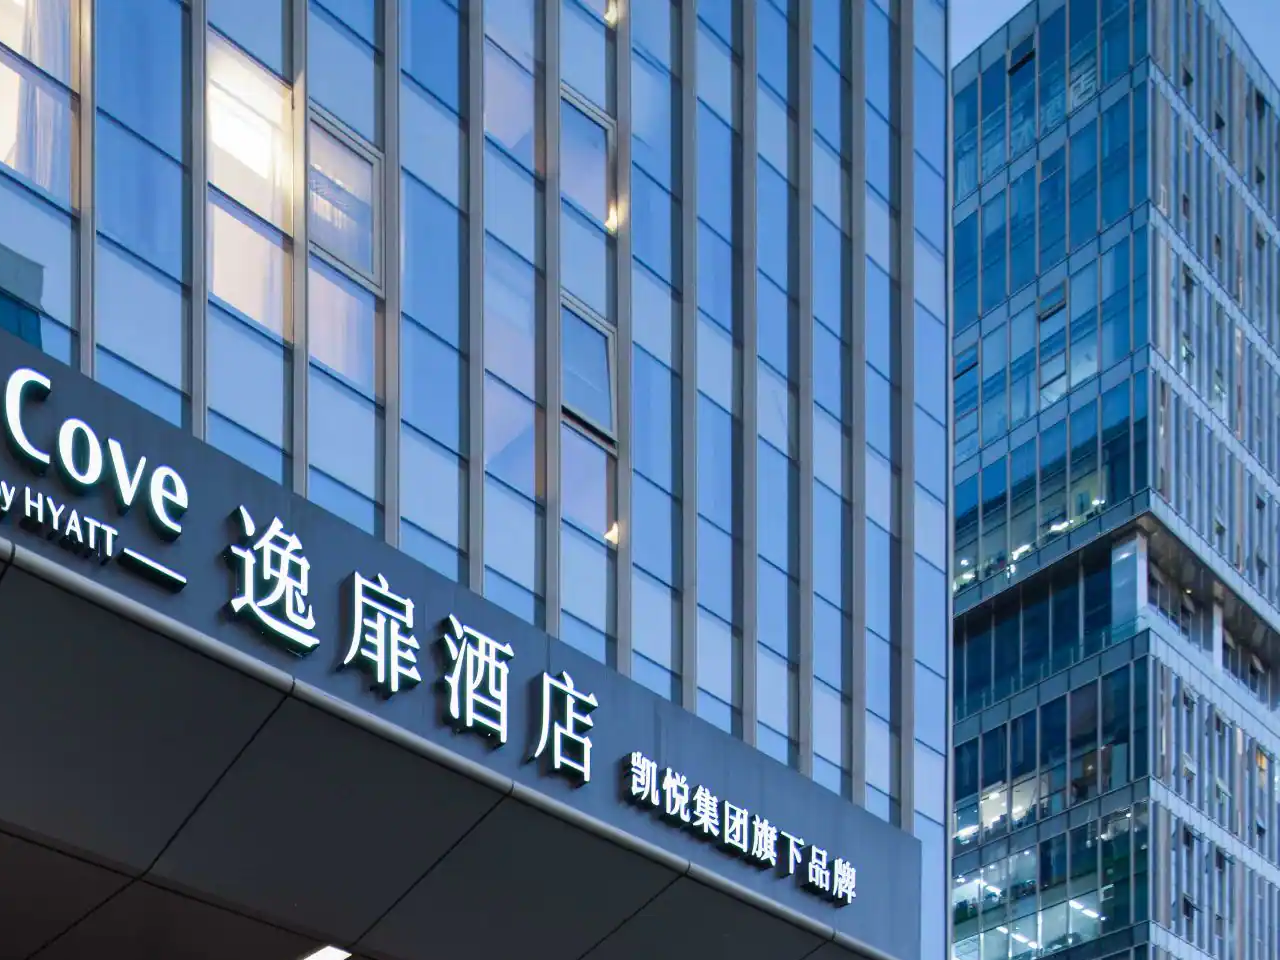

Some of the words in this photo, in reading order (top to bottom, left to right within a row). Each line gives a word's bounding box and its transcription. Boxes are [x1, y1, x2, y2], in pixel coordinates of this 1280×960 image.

[23, 486, 119, 558] HYATT
[230, 504, 600, 783] 逸扉酒店
[629, 751, 858, 905] 凯悦集团旗下品牌
